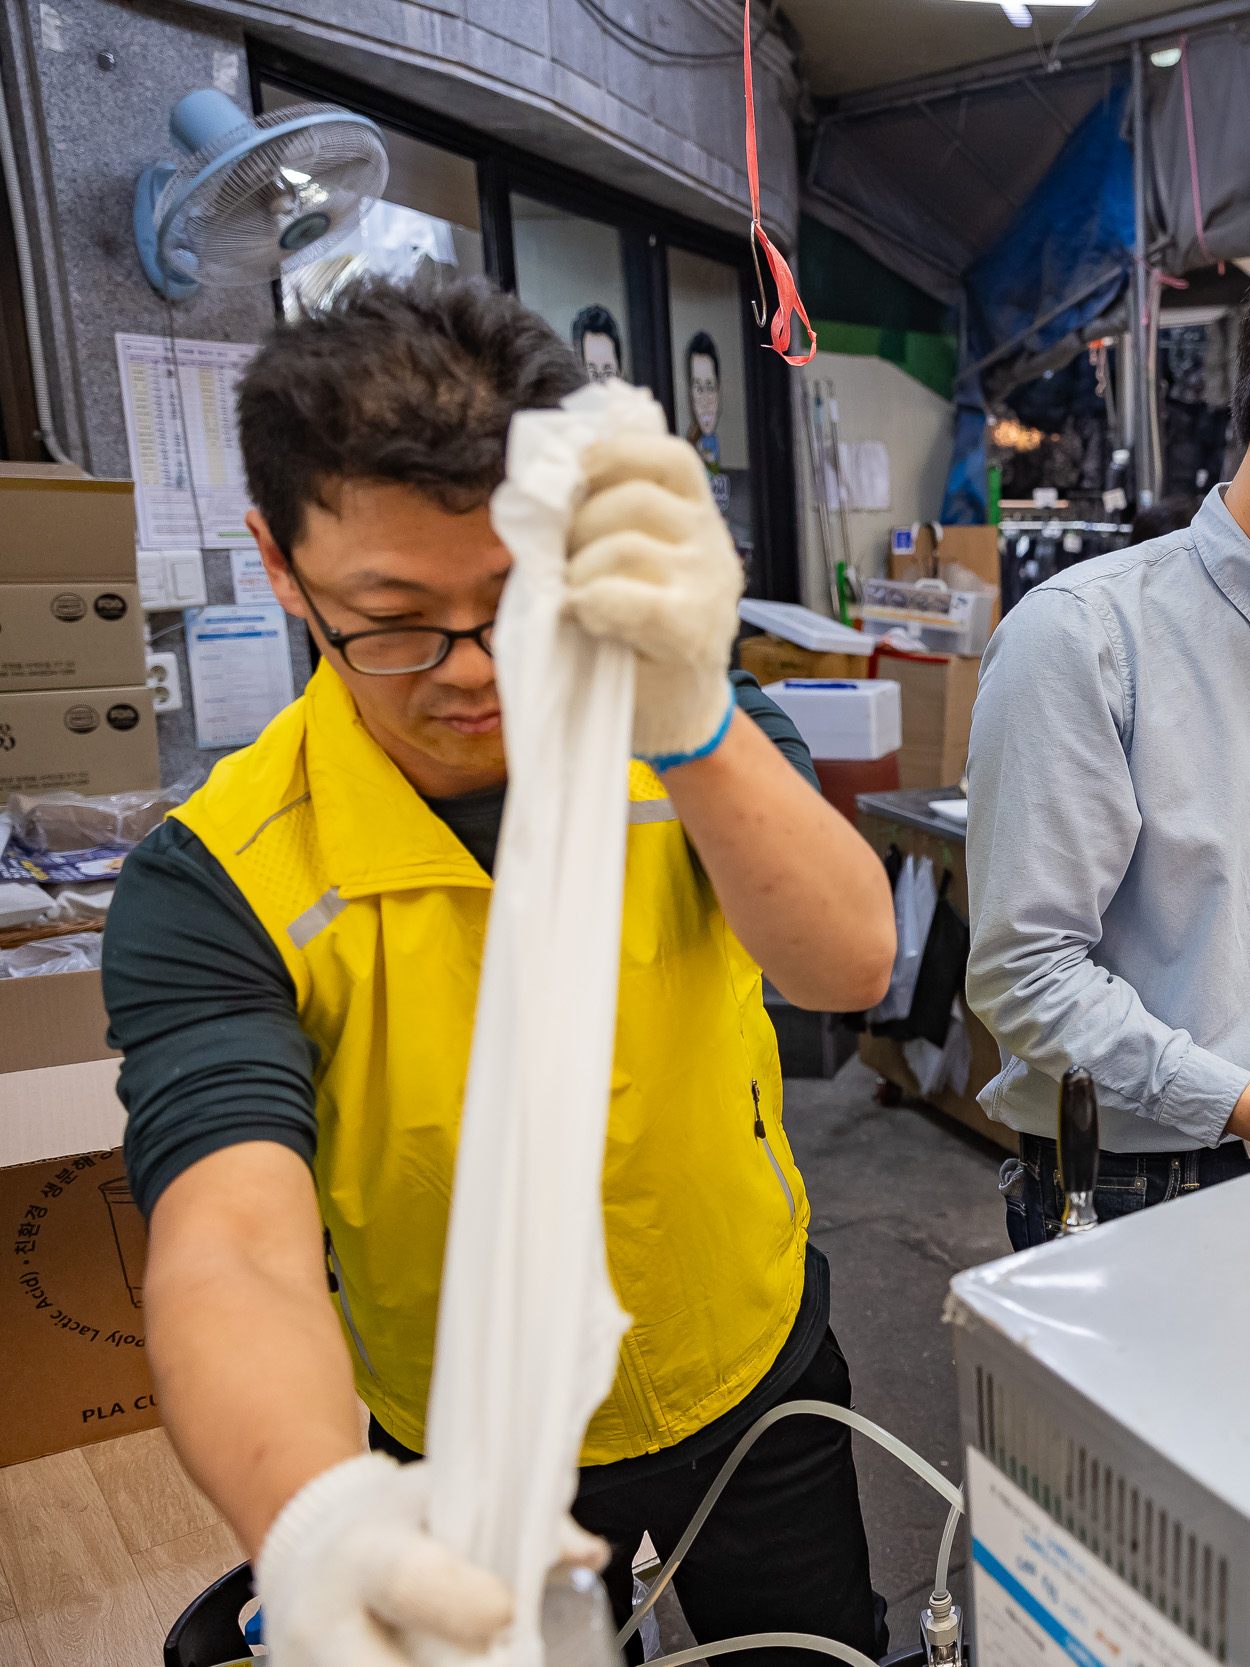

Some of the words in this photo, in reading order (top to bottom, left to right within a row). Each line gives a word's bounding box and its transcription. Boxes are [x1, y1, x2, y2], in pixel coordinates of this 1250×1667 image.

[14, 1204, 48, 1255] 친환경
[19, 1271, 53, 1310] Acid)
[49, 1309, 101, 1342] Lactic
[82, 1402, 125, 1423] PLA
